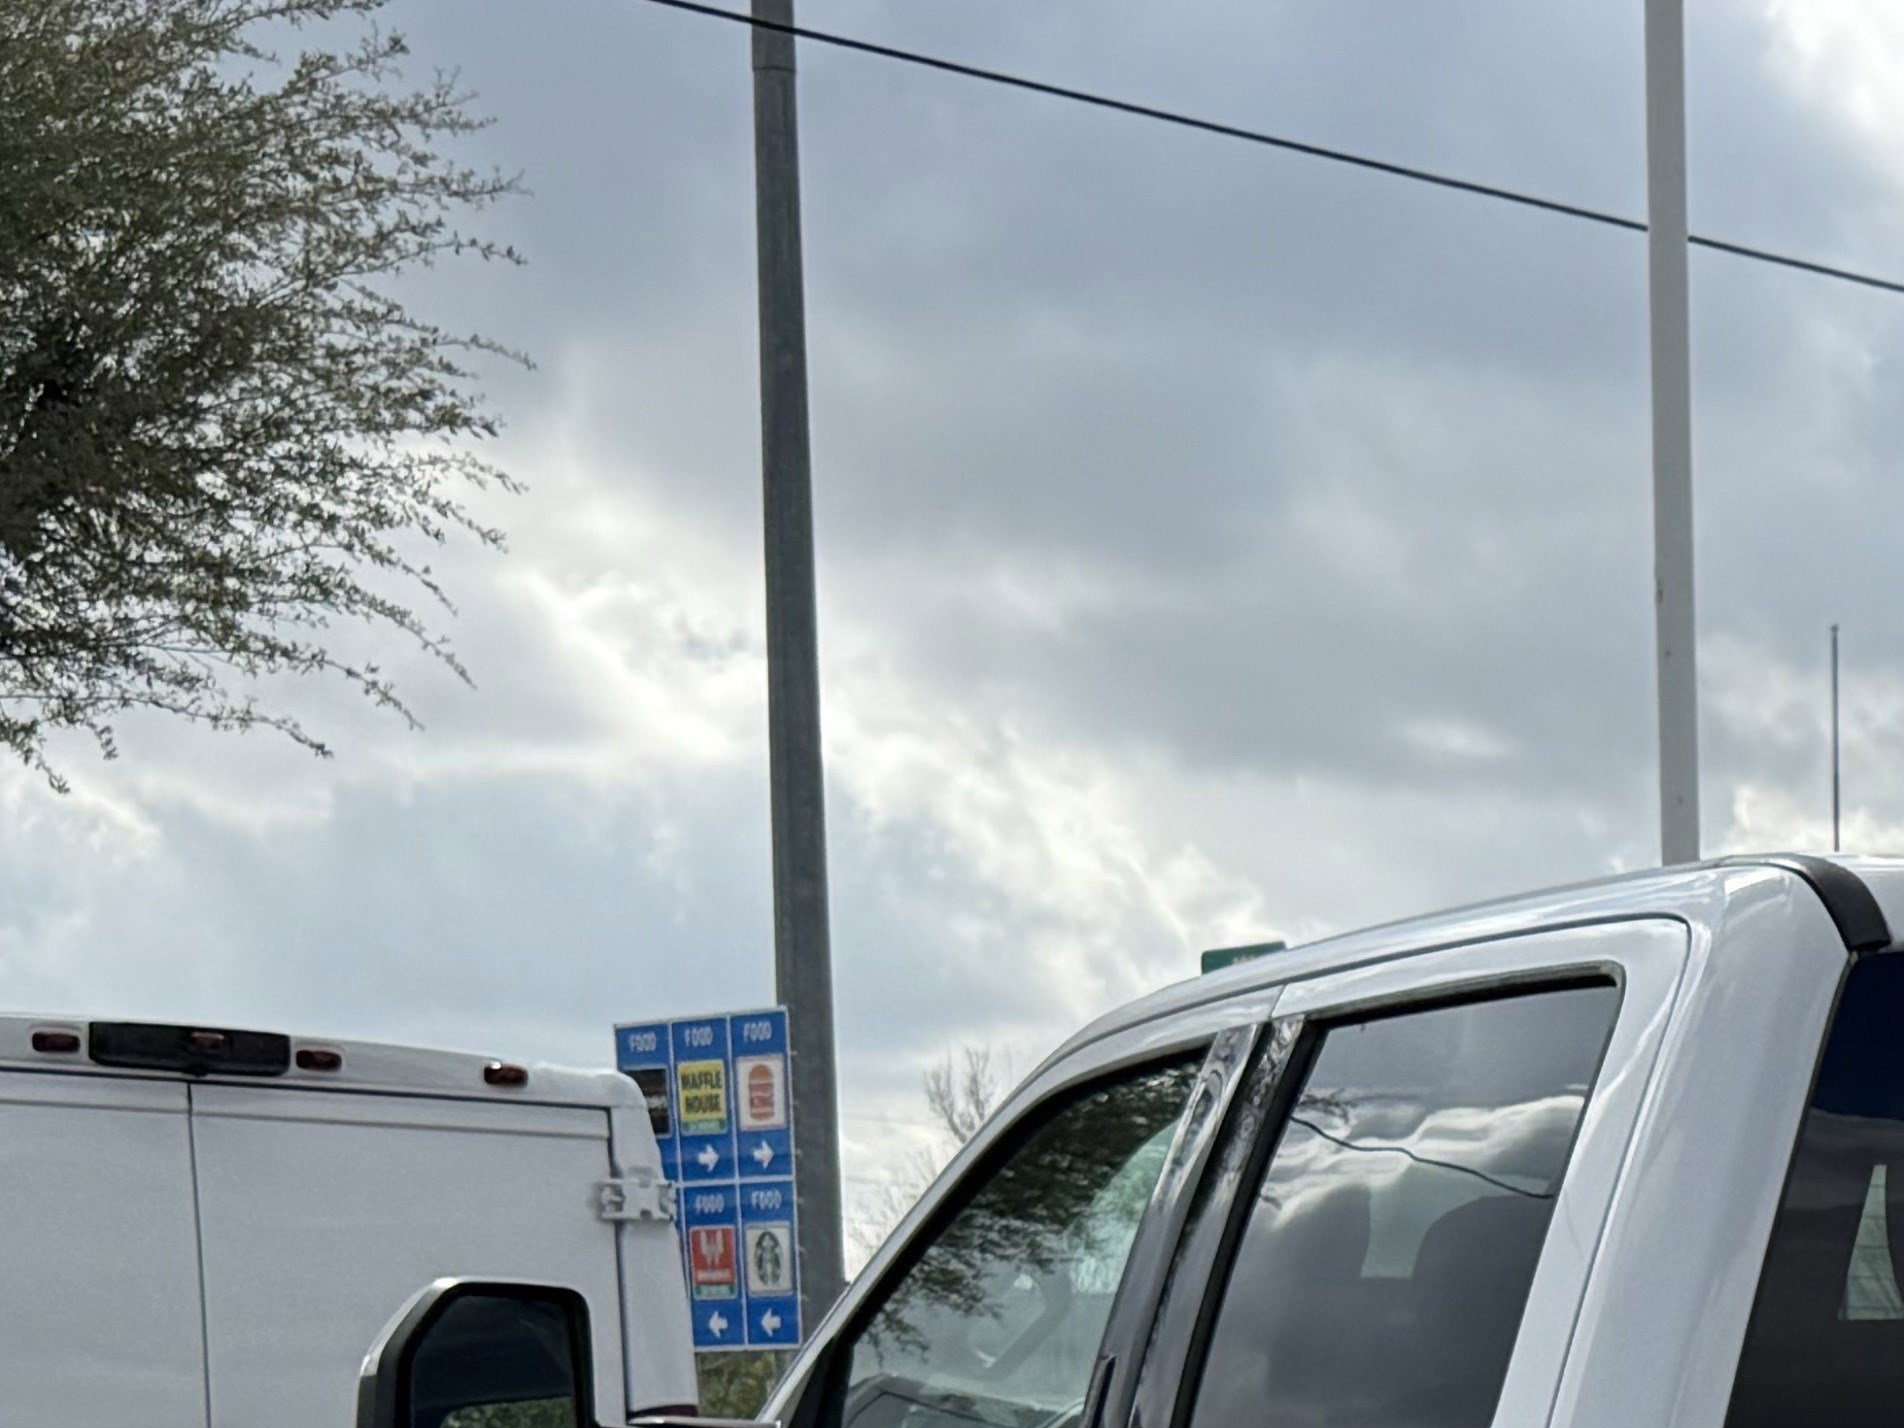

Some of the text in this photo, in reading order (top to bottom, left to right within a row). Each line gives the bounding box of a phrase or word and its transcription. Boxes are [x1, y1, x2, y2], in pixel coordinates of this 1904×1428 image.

[685, 1026, 714, 1048] FOOD
[743, 1020, 773, 1042] FOOD
[629, 1033, 658, 1052] FOOD
[681, 1070, 722, 1090] WAFFLE
[685, 1093, 722, 1114] HOUSE
[696, 1194, 725, 1214] FOOD
[751, 1190, 782, 1211] FOOD
